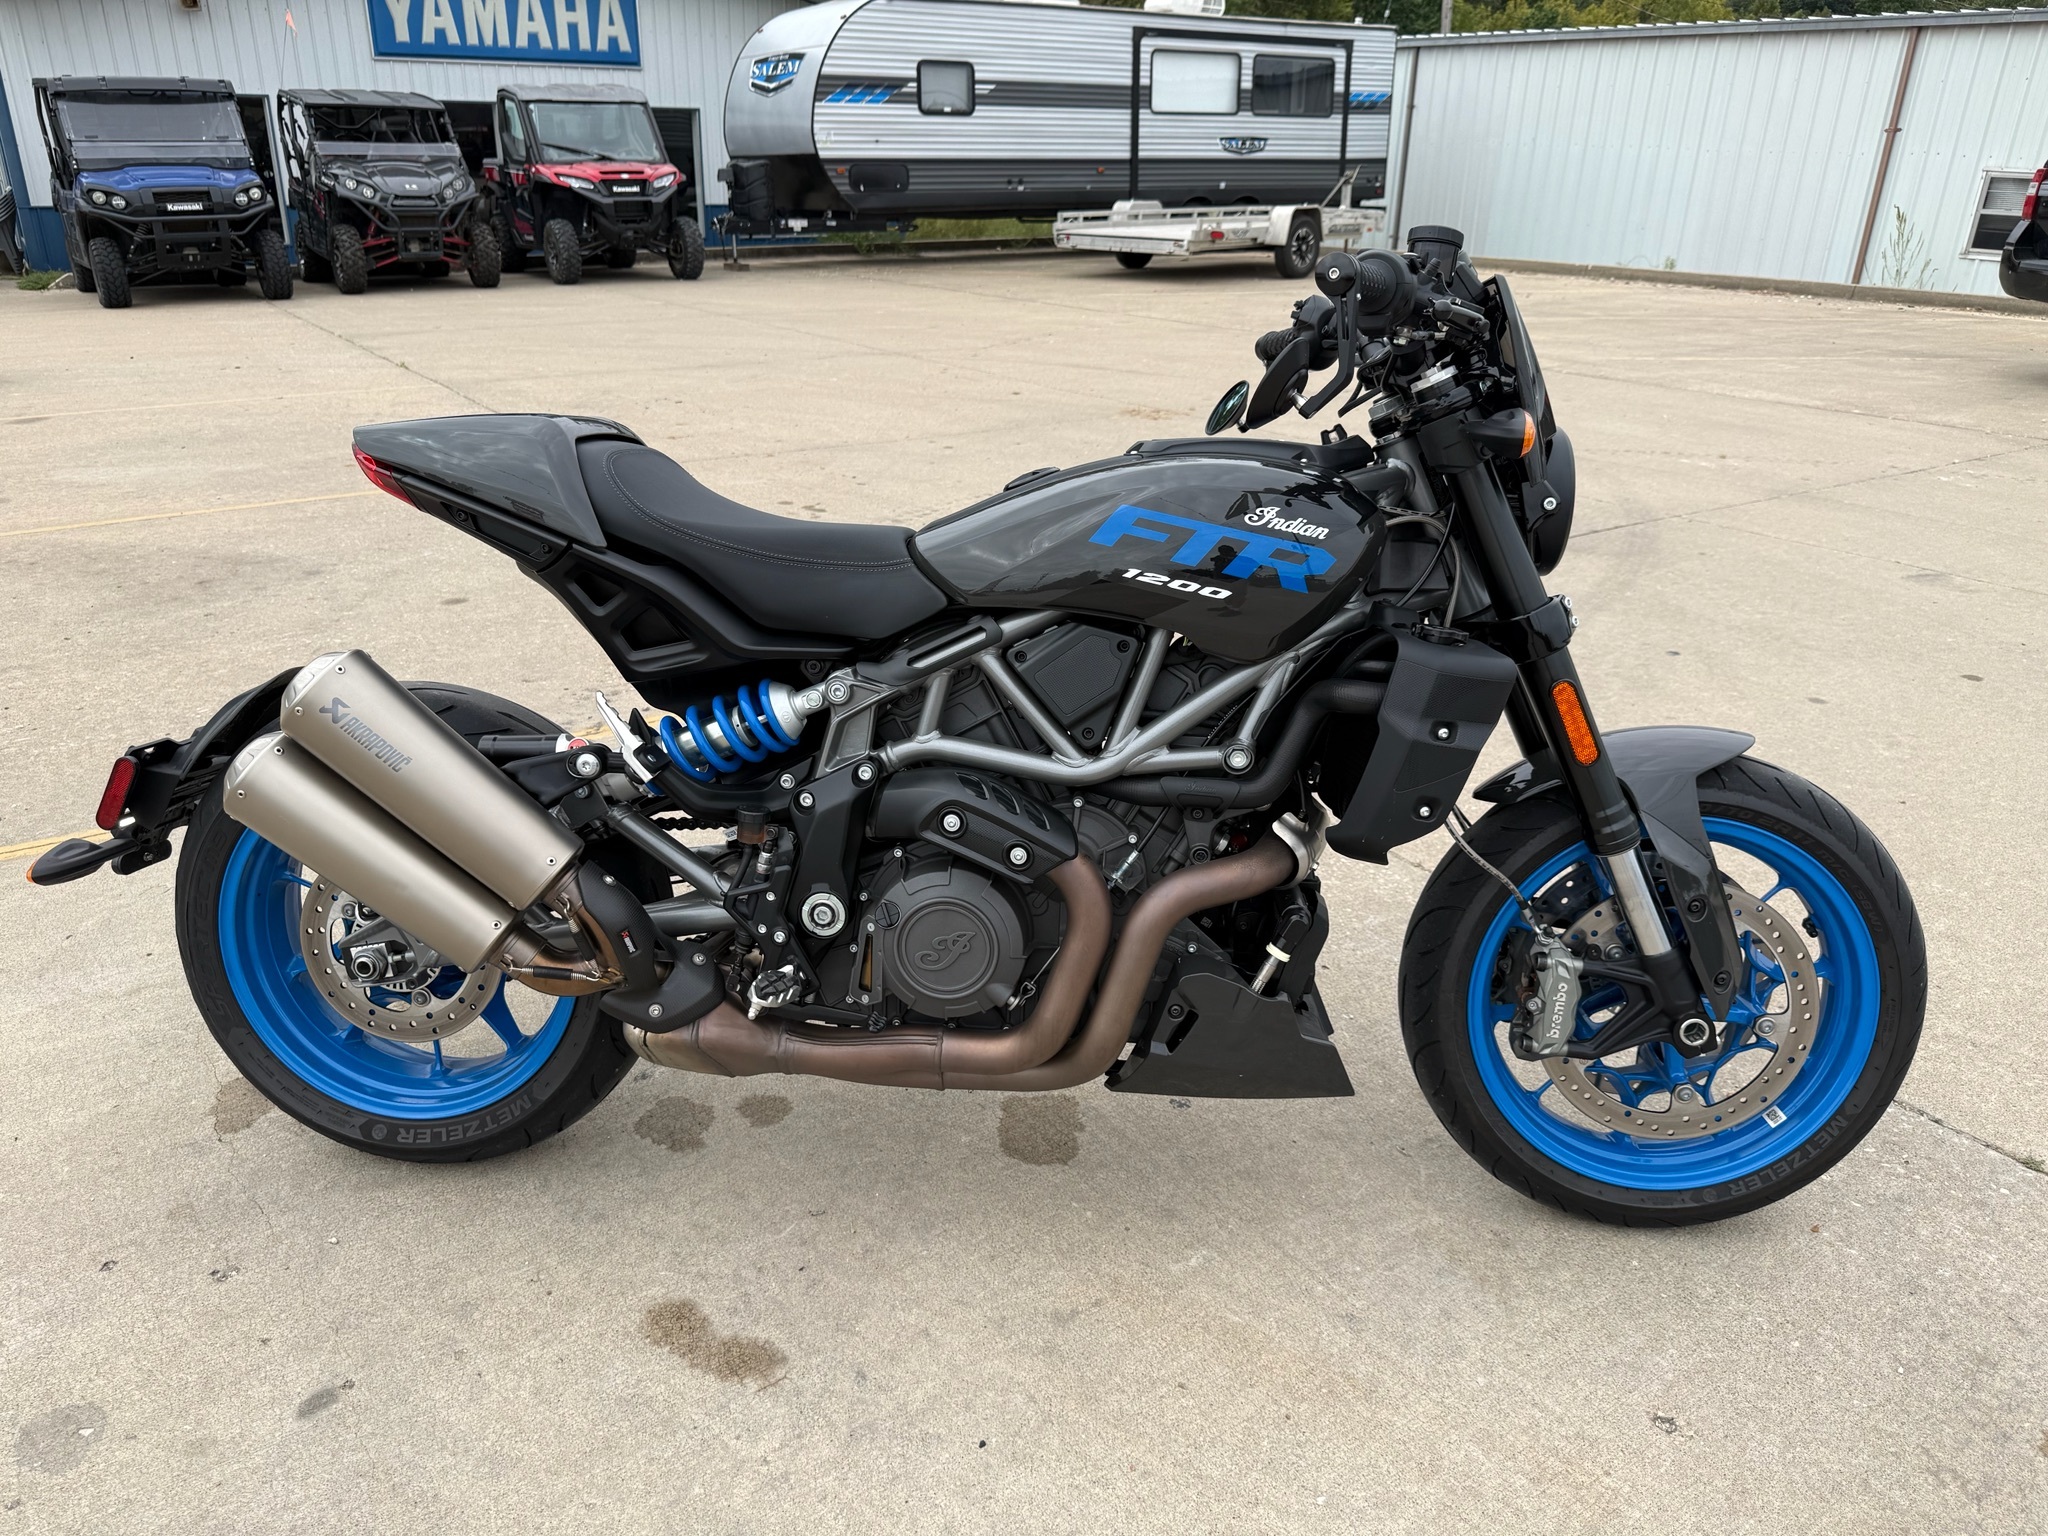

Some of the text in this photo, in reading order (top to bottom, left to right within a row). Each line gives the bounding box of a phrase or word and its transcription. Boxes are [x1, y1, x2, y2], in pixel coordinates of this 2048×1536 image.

[384, 0, 632, 53] YAMAHA
[752, 60, 800, 77] SALEM
[165, 202, 204, 211] Kawasaki
[1243, 505, 1330, 540] Indian
[1088, 504, 1337, 594] FTR
[1121, 568, 1233, 600] 1200
[1546, 982, 1568, 1039] brembo
[396, 1094, 533, 1144] METZELER
[1728, 1114, 1849, 1197] METZELER
